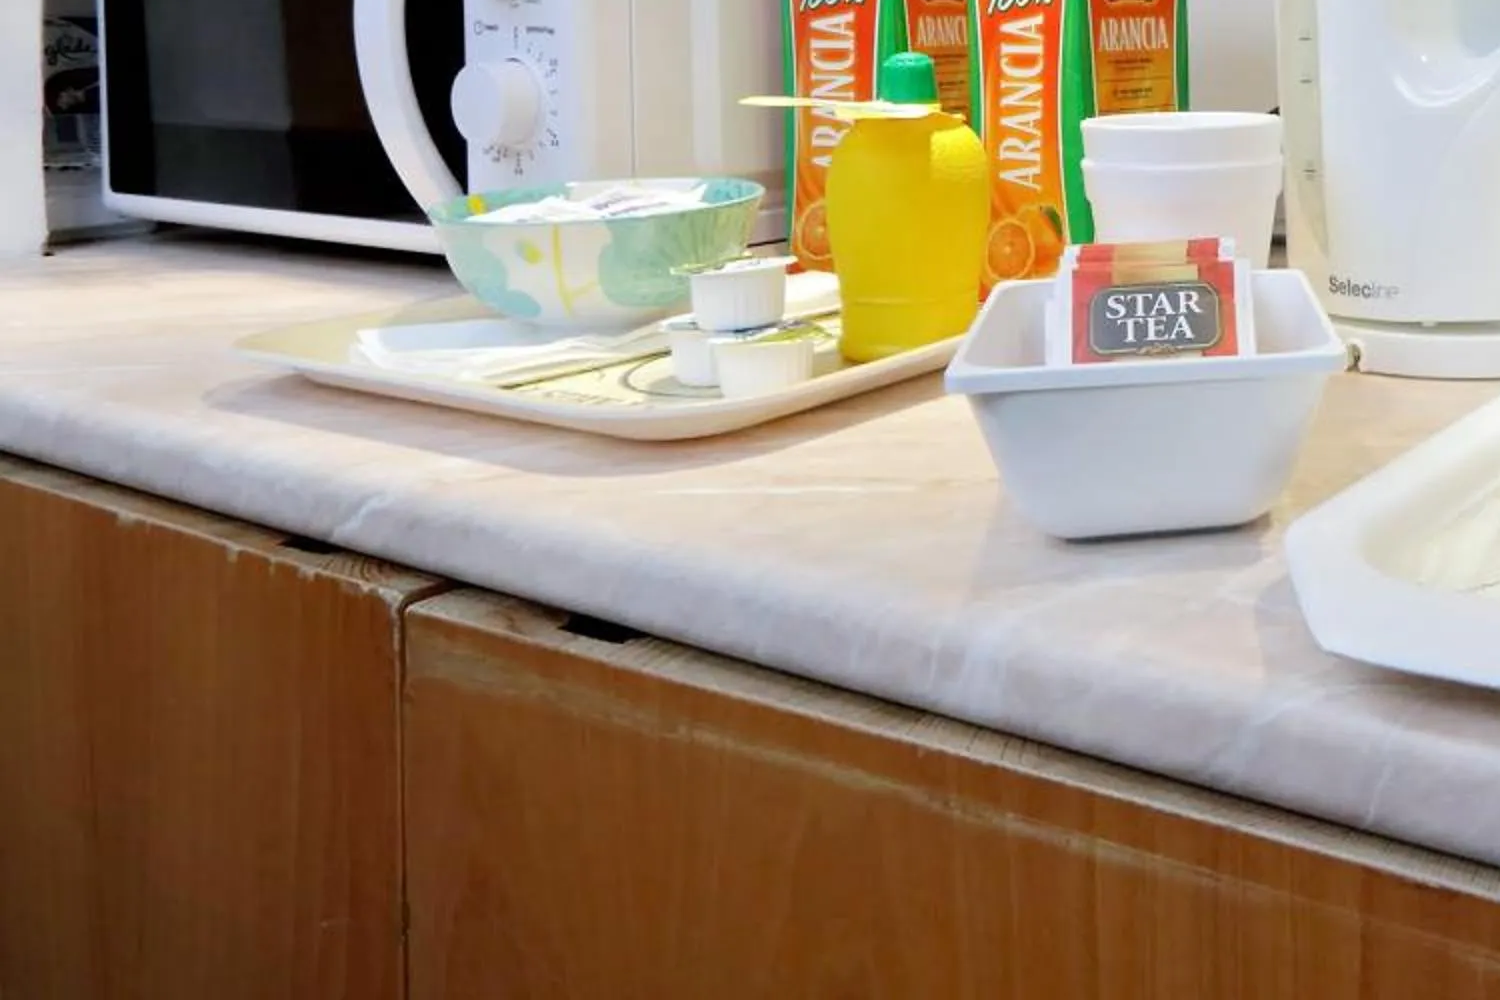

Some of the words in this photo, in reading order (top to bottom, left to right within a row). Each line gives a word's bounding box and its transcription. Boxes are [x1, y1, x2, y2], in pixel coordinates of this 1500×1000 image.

[1098, 17, 1168, 50] ARANCIA
[999, 13, 1045, 190] ARANCIA
[1105, 291, 1203, 319] STAR
[1117, 315, 1195, 342] TEA
